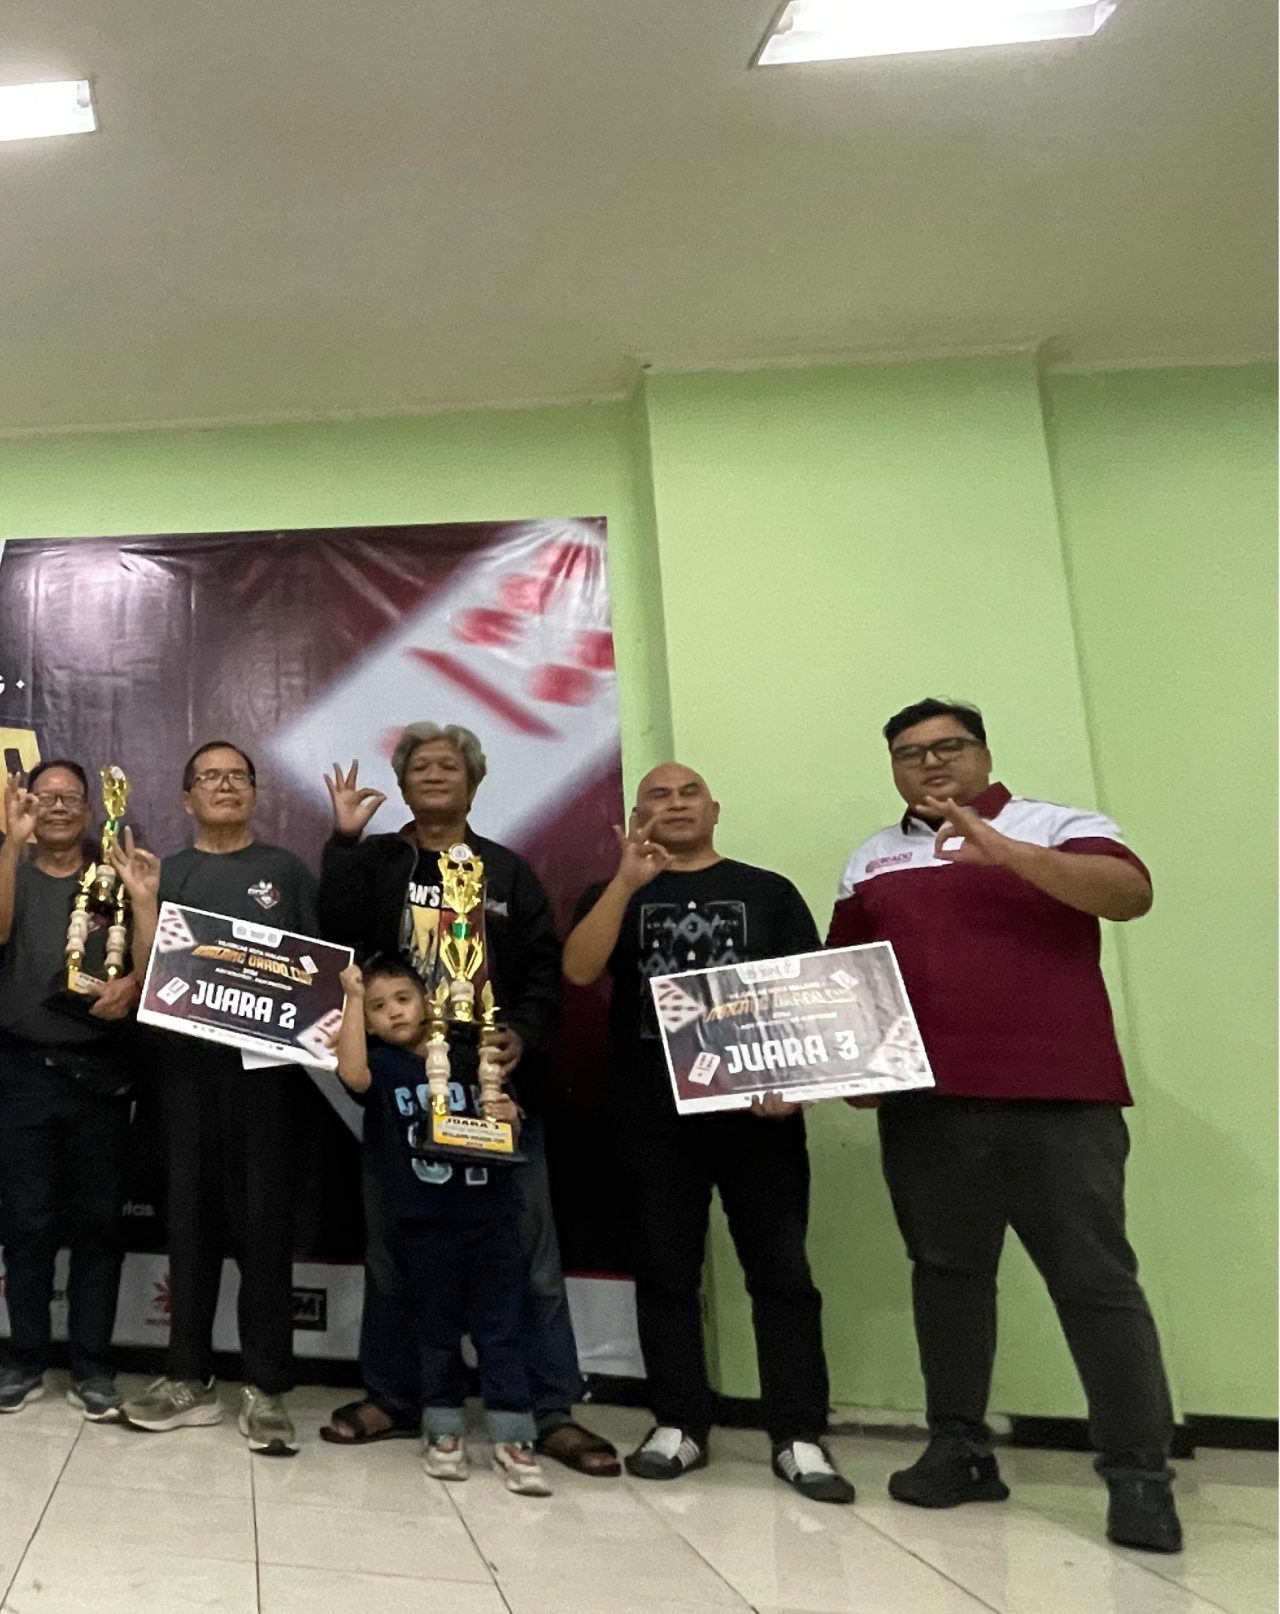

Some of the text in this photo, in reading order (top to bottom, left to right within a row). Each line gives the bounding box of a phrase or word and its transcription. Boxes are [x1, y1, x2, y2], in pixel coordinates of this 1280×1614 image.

[191, 980, 298, 1030] JUARA 2
[724, 1030, 860, 1074] JUARA 3
